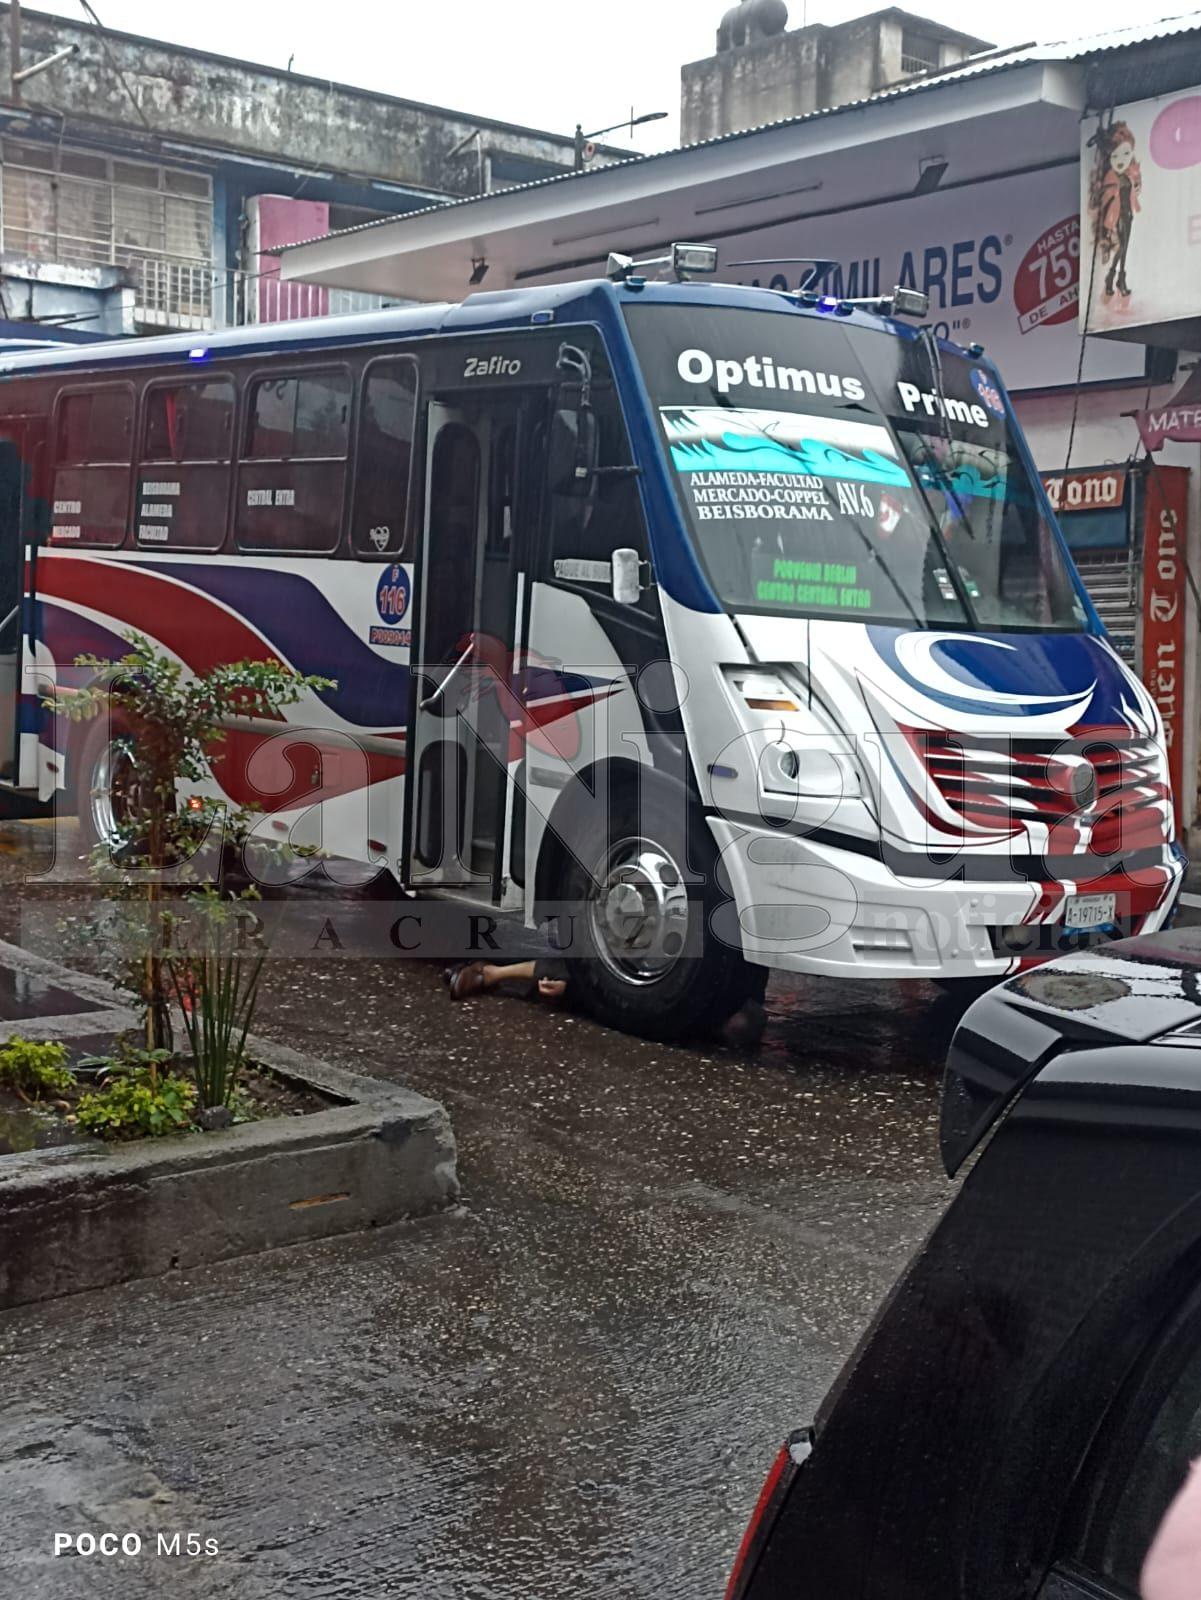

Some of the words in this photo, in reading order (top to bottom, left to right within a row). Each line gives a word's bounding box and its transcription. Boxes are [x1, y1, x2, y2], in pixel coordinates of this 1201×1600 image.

[1037, 221, 1080, 253] HASTA
[1029, 306, 1048, 324] DE
[463, 355, 521, 377] Zafiro
[677, 349, 866, 401] Optimus
[897, 381, 989, 428] Prime
[690, 471, 823, 489] ALAMEDA-FACULTAD
[693, 488, 829, 505] MERCADO-COPPEL
[1044, 476, 1118, 509] Tono
[698, 504, 834, 521] BEISBORAMA
[380, 585, 405, 615] 116
